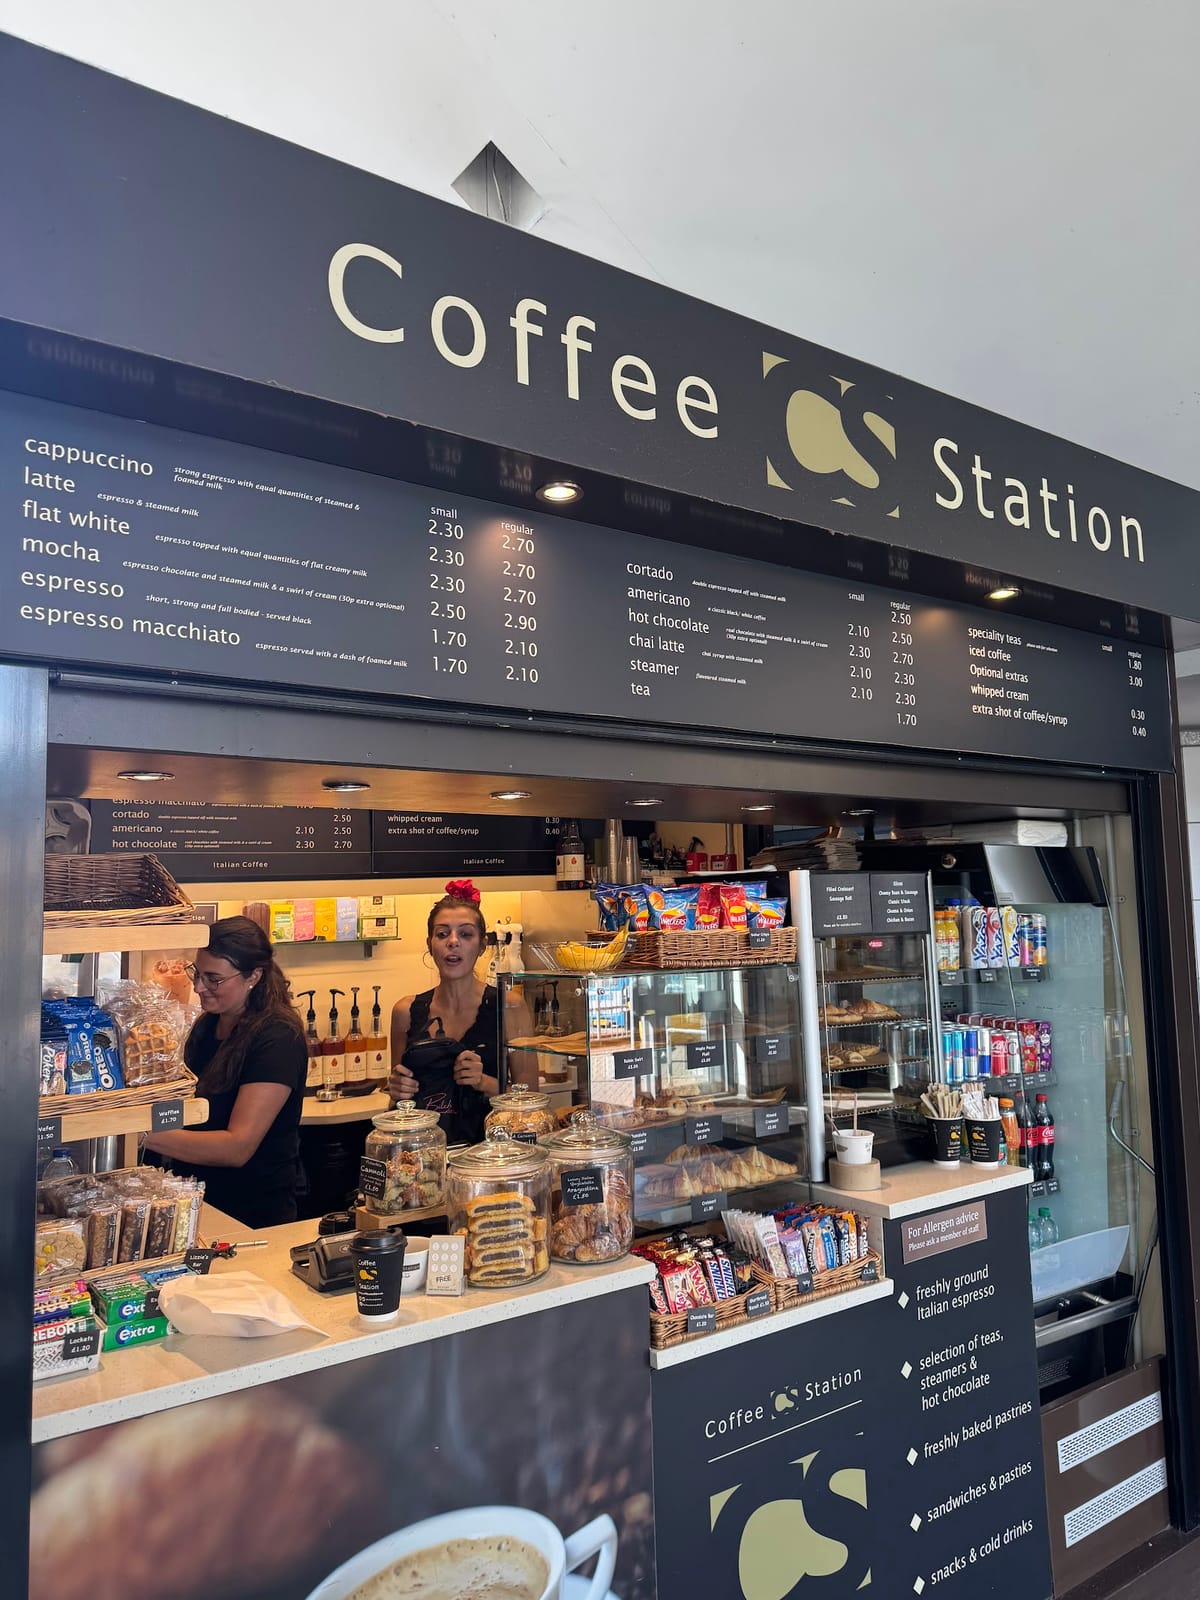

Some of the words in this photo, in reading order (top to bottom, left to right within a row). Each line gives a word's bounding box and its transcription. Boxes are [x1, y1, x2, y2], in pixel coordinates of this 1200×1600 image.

[328, 245, 718, 438] Coffee
[25, 439, 152, 475] cappuccino
[25, 466, 75, 492] latte
[173, 474, 204, 486] foamed
[205, 482, 222, 490] milk
[174, 467, 200, 478] strong
[202, 473, 235, 484] espresso
[237, 479, 253, 488] with
[255, 484, 276, 492] equal
[277, 488, 313, 500] quantities
[324, 498, 353, 509] steamed
[97, 493, 134, 504] espresso
[145, 502, 179, 512] steamed
[181, 508, 199, 516] milk
[933, 438, 1144, 562] Station
[22, 499, 61, 523] flat
[69, 510, 129, 534] white
[430, 506, 457, 519] small
[428, 519, 463, 539] 2.30
[501, 522, 533, 535] regular
[23, 537, 100, 562] mocha
[502, 534, 534, 553] 2.70
[155, 535, 190, 545] espresso
[192, 540, 219, 550] topped
[221, 545, 238, 554] with
[240, 549, 261, 558] equal
[262, 554, 299, 564] quantities
[310, 561, 323, 569] flat
[325, 565, 351, 575] creamy
[429, 546, 464, 566] 2.30
[503, 560, 535, 579] 2.70
[626, 563, 673, 580] cortado
[21, 571, 123, 597] espresso
[430, 573, 464, 593] 2.30
[503, 586, 535, 605] 2.70
[627, 587, 690, 607] americano
[848, 592, 864, 601] small
[430, 601, 465, 620] 2.50
[890, 601, 910, 614] regular
[20, 605, 123, 629] espresso
[133, 619, 240, 645] macchiato
[504, 613, 536, 631] 2.90
[628, 608, 649, 624] hot
[653, 612, 709, 633] chocolate
[891, 611, 911, 625] 2.50
[432, 628, 466, 647] 1.70
[848, 623, 869, 638] 2.10
[892, 631, 912, 645] 2.50
[968, 627, 1004, 644] speciality
[1006, 634, 1021, 645] teas
[505, 639, 537, 656] 2.10
[629, 633, 653, 648] chai
[658, 636, 684, 653] latte
[849, 644, 870, 658] 2.30
[893, 651, 913, 665] 2.70
[968, 644, 985, 657] iced
[987, 648, 1011, 661] coffee
[433, 656, 467, 674] 1.70
[630, 659, 679, 675] steamer
[850, 665, 871, 679] 2.10
[969, 663, 1003, 679] Optional
[1005, 671, 1028, 683] extras
[1128, 658, 1141, 670] 1.80
[506, 665, 538, 683] 2.10
[894, 671, 914, 685] 2.30
[1128, 675, 1142, 687] 3.00
[631, 682, 650, 696] tea
[851, 686, 872, 700] 2.10
[970, 684, 1004, 698] whipped
[1006, 690, 1028, 701] cream
[895, 692, 915, 705] 2.30
[897, 712, 916, 726] 1.70
[972, 704, 993, 715] extra
[994, 705, 1011, 717] shot
[1013, 707, 1021, 718] of
[1023, 709, 1067, 727] coffee/syrup
[1130, 708, 1145, 720] 0.30
[1132, 725, 1146, 737] 0.40
[112, 809, 149, 818] cortado
[333, 814, 351, 822] 2.50
[387, 814, 418, 823] whipped
[112, 824, 162, 832] americano
[295, 826, 314, 834] 2.10
[435, 827, 479, 835] coffee/syrup
[112, 839, 128, 848] hot
[131, 839, 177, 848] chocolate
[295, 840, 314, 848] 2.30
[334, 840, 352, 848] 2.70
[94, 1047, 115, 1089] OREO
[908, 1227, 921, 1239] For
[922, 1218, 954, 1234] Allergen
[955, 1210, 979, 1225] advice
[908, 1241, 925, 1251] Please
[926, 1236, 935, 1246] ask
[940, 1230, 960, 1242] member
[960, 1226, 967, 1236] of
[967, 1223, 979, 1234] staff
[435, 1275, 452, 1284] FREE
[688, 1260, 711, 1305] TWIX
[709, 1261, 727, 1300] SNICKE
[720, 1258, 736, 1298] SNICKE
[916, 1278, 950, 1301] freshly
[953, 1263, 988, 1291] ground
[121, 1303, 146, 1316] ext
[917, 1300, 948, 1320] Italian
[951, 1284, 994, 1308] espresso
[33, 1322, 76, 1341] REBOR
[69, 1335, 94, 1345] Lockets
[119, 1325, 155, 1341] extra
[919, 1343, 964, 1370] selection
[968, 1336, 977, 1360] of
[980, 1329, 1003, 1346] teas,
[920, 1362, 966, 1390] steamers
[969, 1355, 977, 1370] &
[805, 1368, 861, 1400] Station
[922, 1393, 939, 1411] hot
[942, 1373, 989, 1401] chocolate
[705, 1406, 763, 1438] Coffee
[924, 1431, 959, 1458] freshly
[962, 1414, 992, 1440] baked
[995, 1400, 1031, 1429] pastries
[927, 1483, 986, 1522] sandwiches
[989, 1476, 996, 1490] &
[998, 1461, 1031, 1490] pasties
[931, 1556, 966, 1584] snacks
[969, 1548, 976, 1563] &
[979, 1534, 1000, 1557] cold
[1003, 1519, 1032, 1544] drinks
